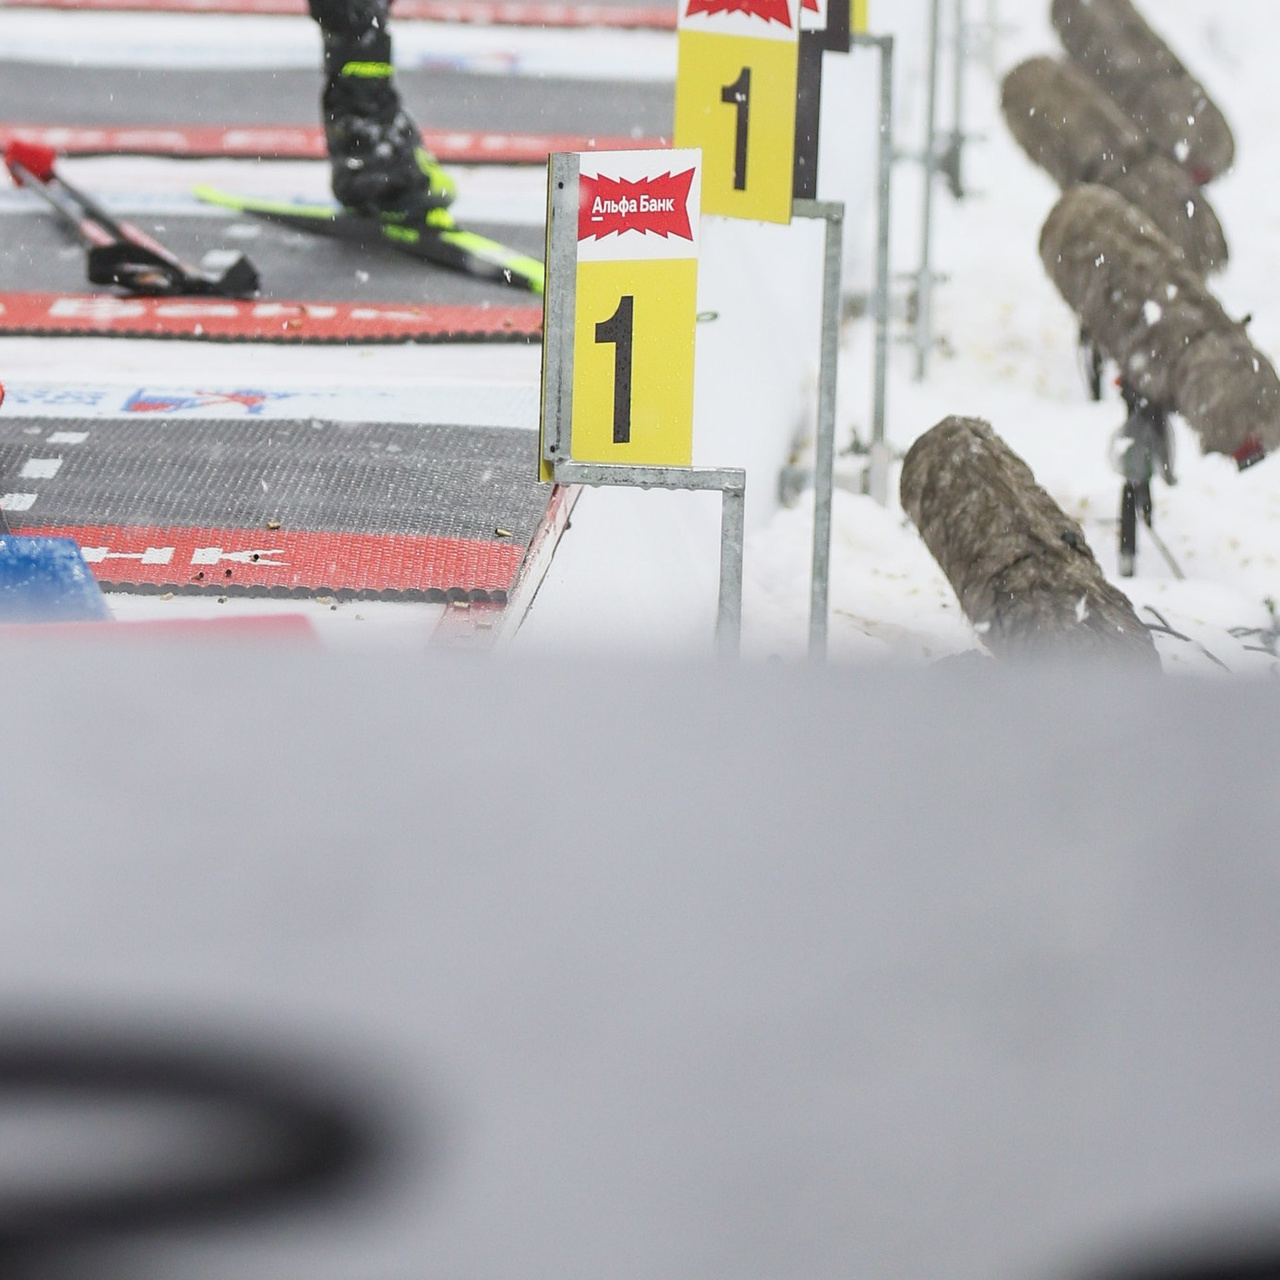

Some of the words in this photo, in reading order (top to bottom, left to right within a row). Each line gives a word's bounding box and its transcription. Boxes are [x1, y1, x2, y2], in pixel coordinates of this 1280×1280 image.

[721, 66, 750, 190] 1
[591, 195, 637, 221] Альфа
[639, 194, 674, 213] Банк
[595, 295, 634, 444] 1
